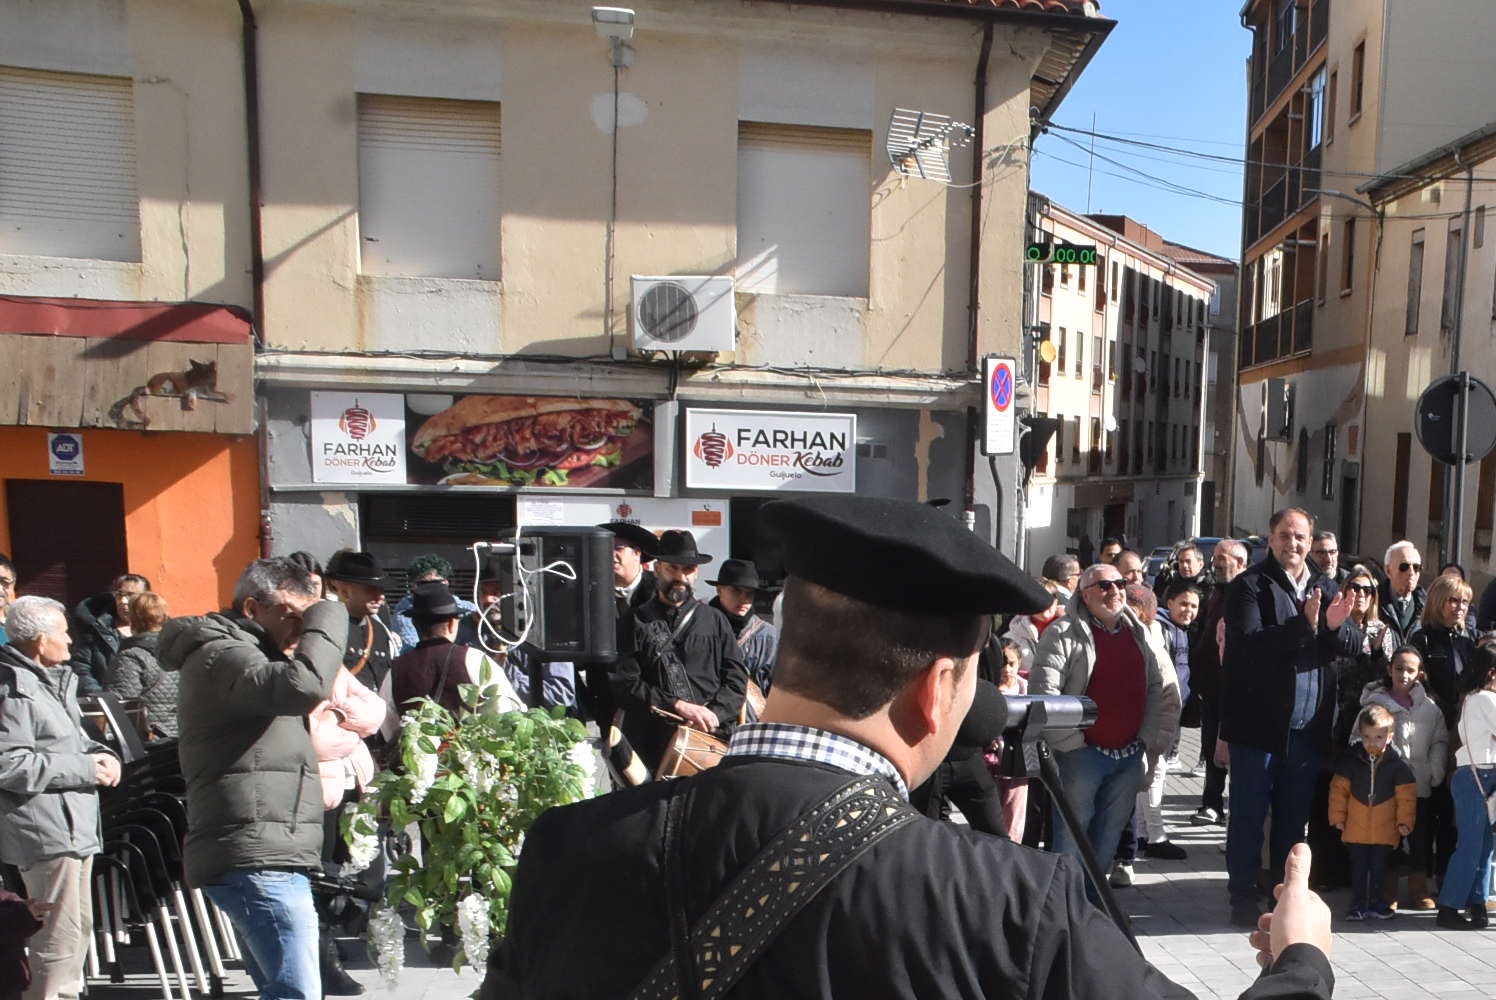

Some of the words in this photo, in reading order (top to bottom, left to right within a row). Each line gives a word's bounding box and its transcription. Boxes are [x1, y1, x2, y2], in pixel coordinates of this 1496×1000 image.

[737, 428, 845, 450] FARHAN
[324, 443, 397, 456] FARHAN
[324, 457, 360, 466] DÖNER
[362, 456, 396, 472] Kebab
[737, 451, 790, 466] DÖNER
[793, 451, 844, 476] Kebab
[770, 470, 801, 480] Guijuelo
